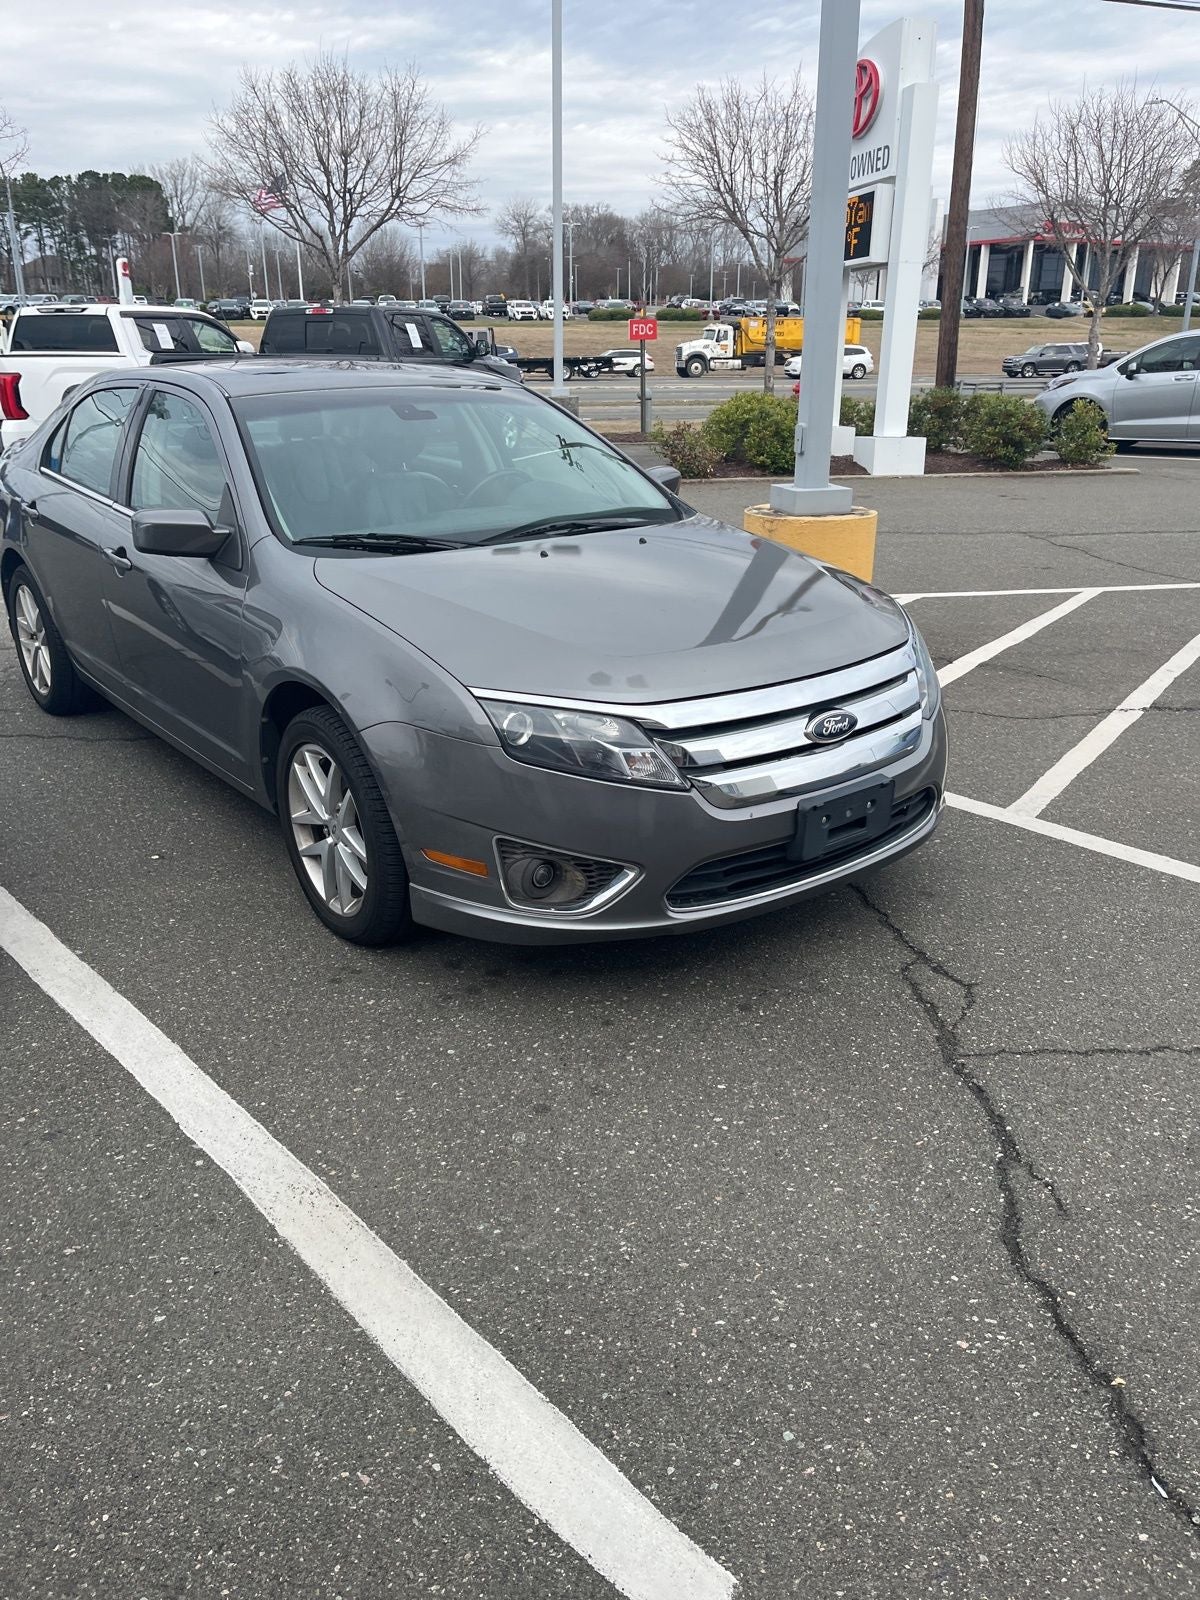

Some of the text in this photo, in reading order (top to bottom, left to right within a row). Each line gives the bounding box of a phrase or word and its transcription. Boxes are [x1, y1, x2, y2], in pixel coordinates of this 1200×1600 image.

[850, 145, 890, 180] OWNED
[632, 323, 654, 335] FDC
[822, 715, 850, 736] Ford
